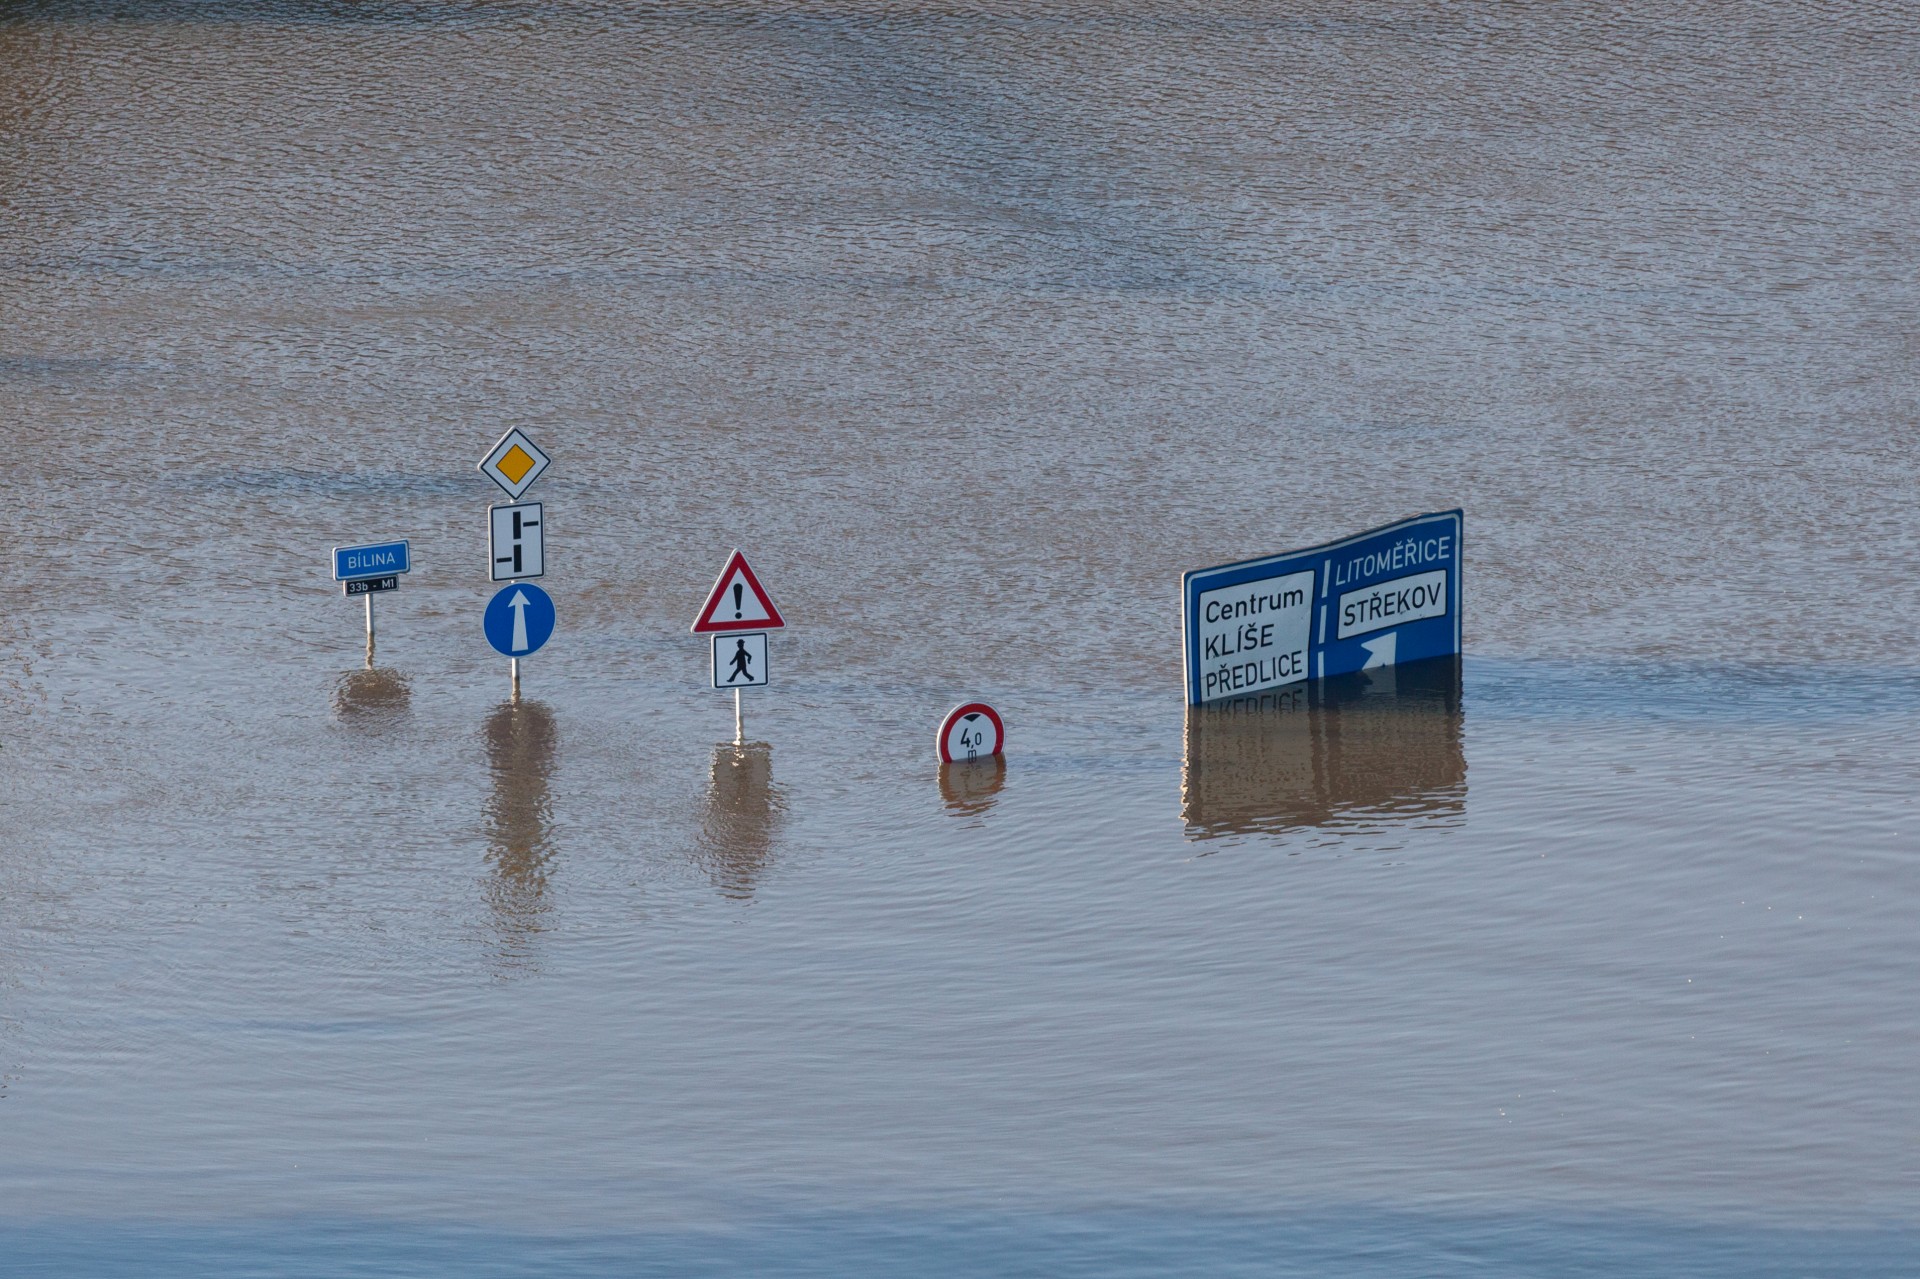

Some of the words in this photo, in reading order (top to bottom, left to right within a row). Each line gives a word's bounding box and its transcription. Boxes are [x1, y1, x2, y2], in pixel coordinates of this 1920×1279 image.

[348, 552, 396, 569] BÍLINA
[1335, 536, 1451, 586] LITOMĚŘICE
[349, 582, 368, 593] 33b
[381, 578, 394, 589] M1
[1206, 588, 1304, 623] Centrum
[1343, 582, 1442, 627] STŘEKOV
[1205, 621, 1275, 660] KLÍŠE
[1206, 650, 1303, 697] PŘEDLICE
[960, 728, 982, 749] 4,0
